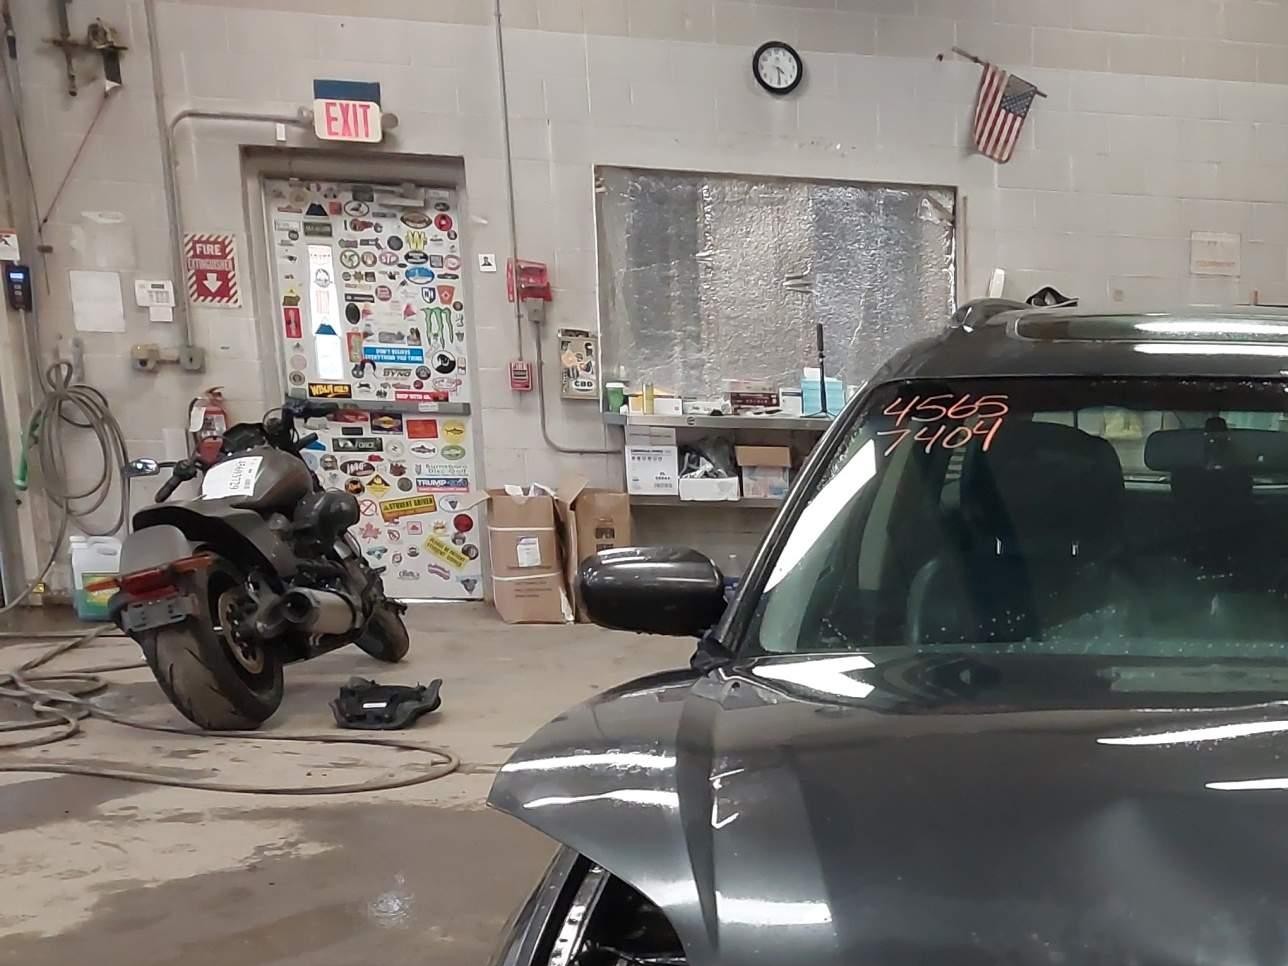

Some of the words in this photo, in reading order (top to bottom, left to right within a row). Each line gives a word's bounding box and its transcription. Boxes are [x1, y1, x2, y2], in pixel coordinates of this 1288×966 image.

[325, 102, 370, 138] EXIT
[195, 243, 222, 256] FIRE
[883, 393, 1009, 427] 4565
[876, 417, 1003, 457] 7404
[417, 479, 447, 487] TRUMP
